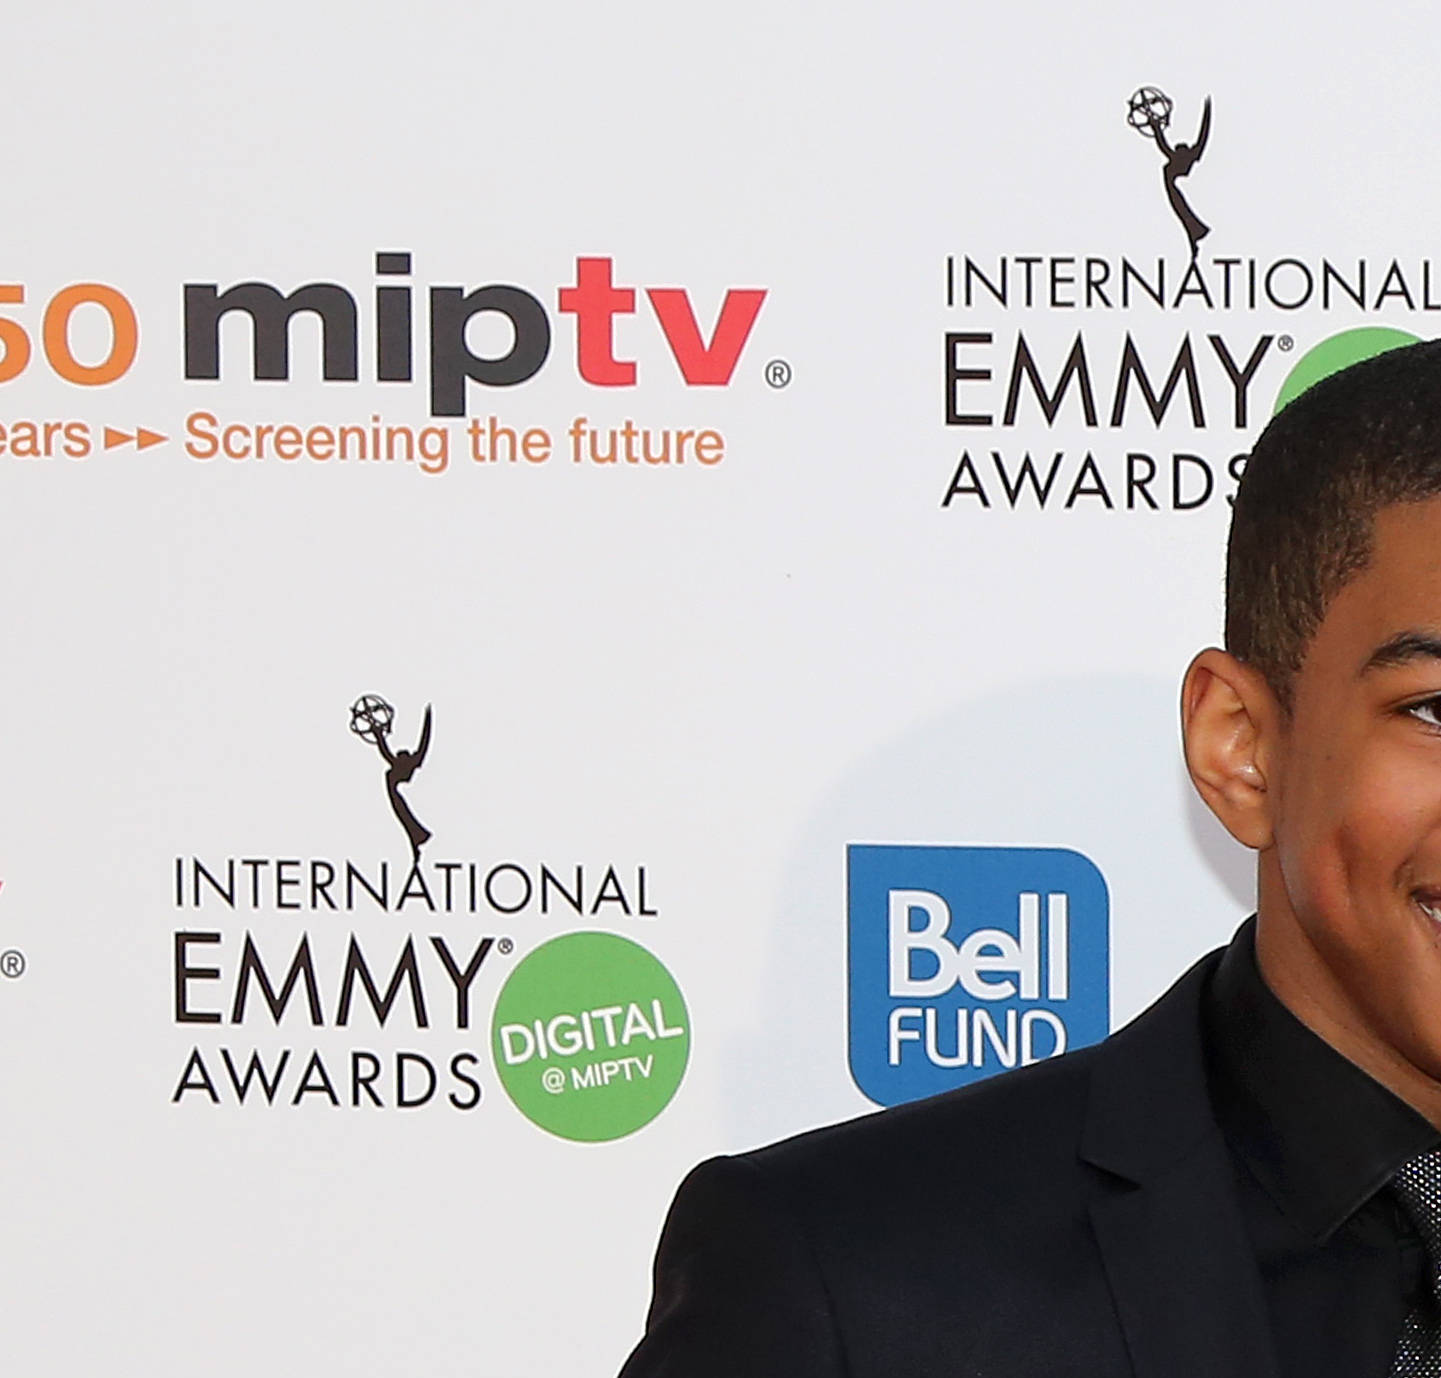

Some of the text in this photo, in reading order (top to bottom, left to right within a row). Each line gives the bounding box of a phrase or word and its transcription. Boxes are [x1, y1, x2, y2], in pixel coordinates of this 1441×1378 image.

[0, 412, 724, 474] ars Screening the future
[176, 857, 657, 916] INTERNATIONAL
[888, 889, 1068, 1001] Bell
[500, 999, 684, 1065] DIGITAL
[889, 1007, 1066, 1068] FUND
[172, 1047, 481, 1111] AWARDS
[571, 1054, 654, 1090] MIPTV
